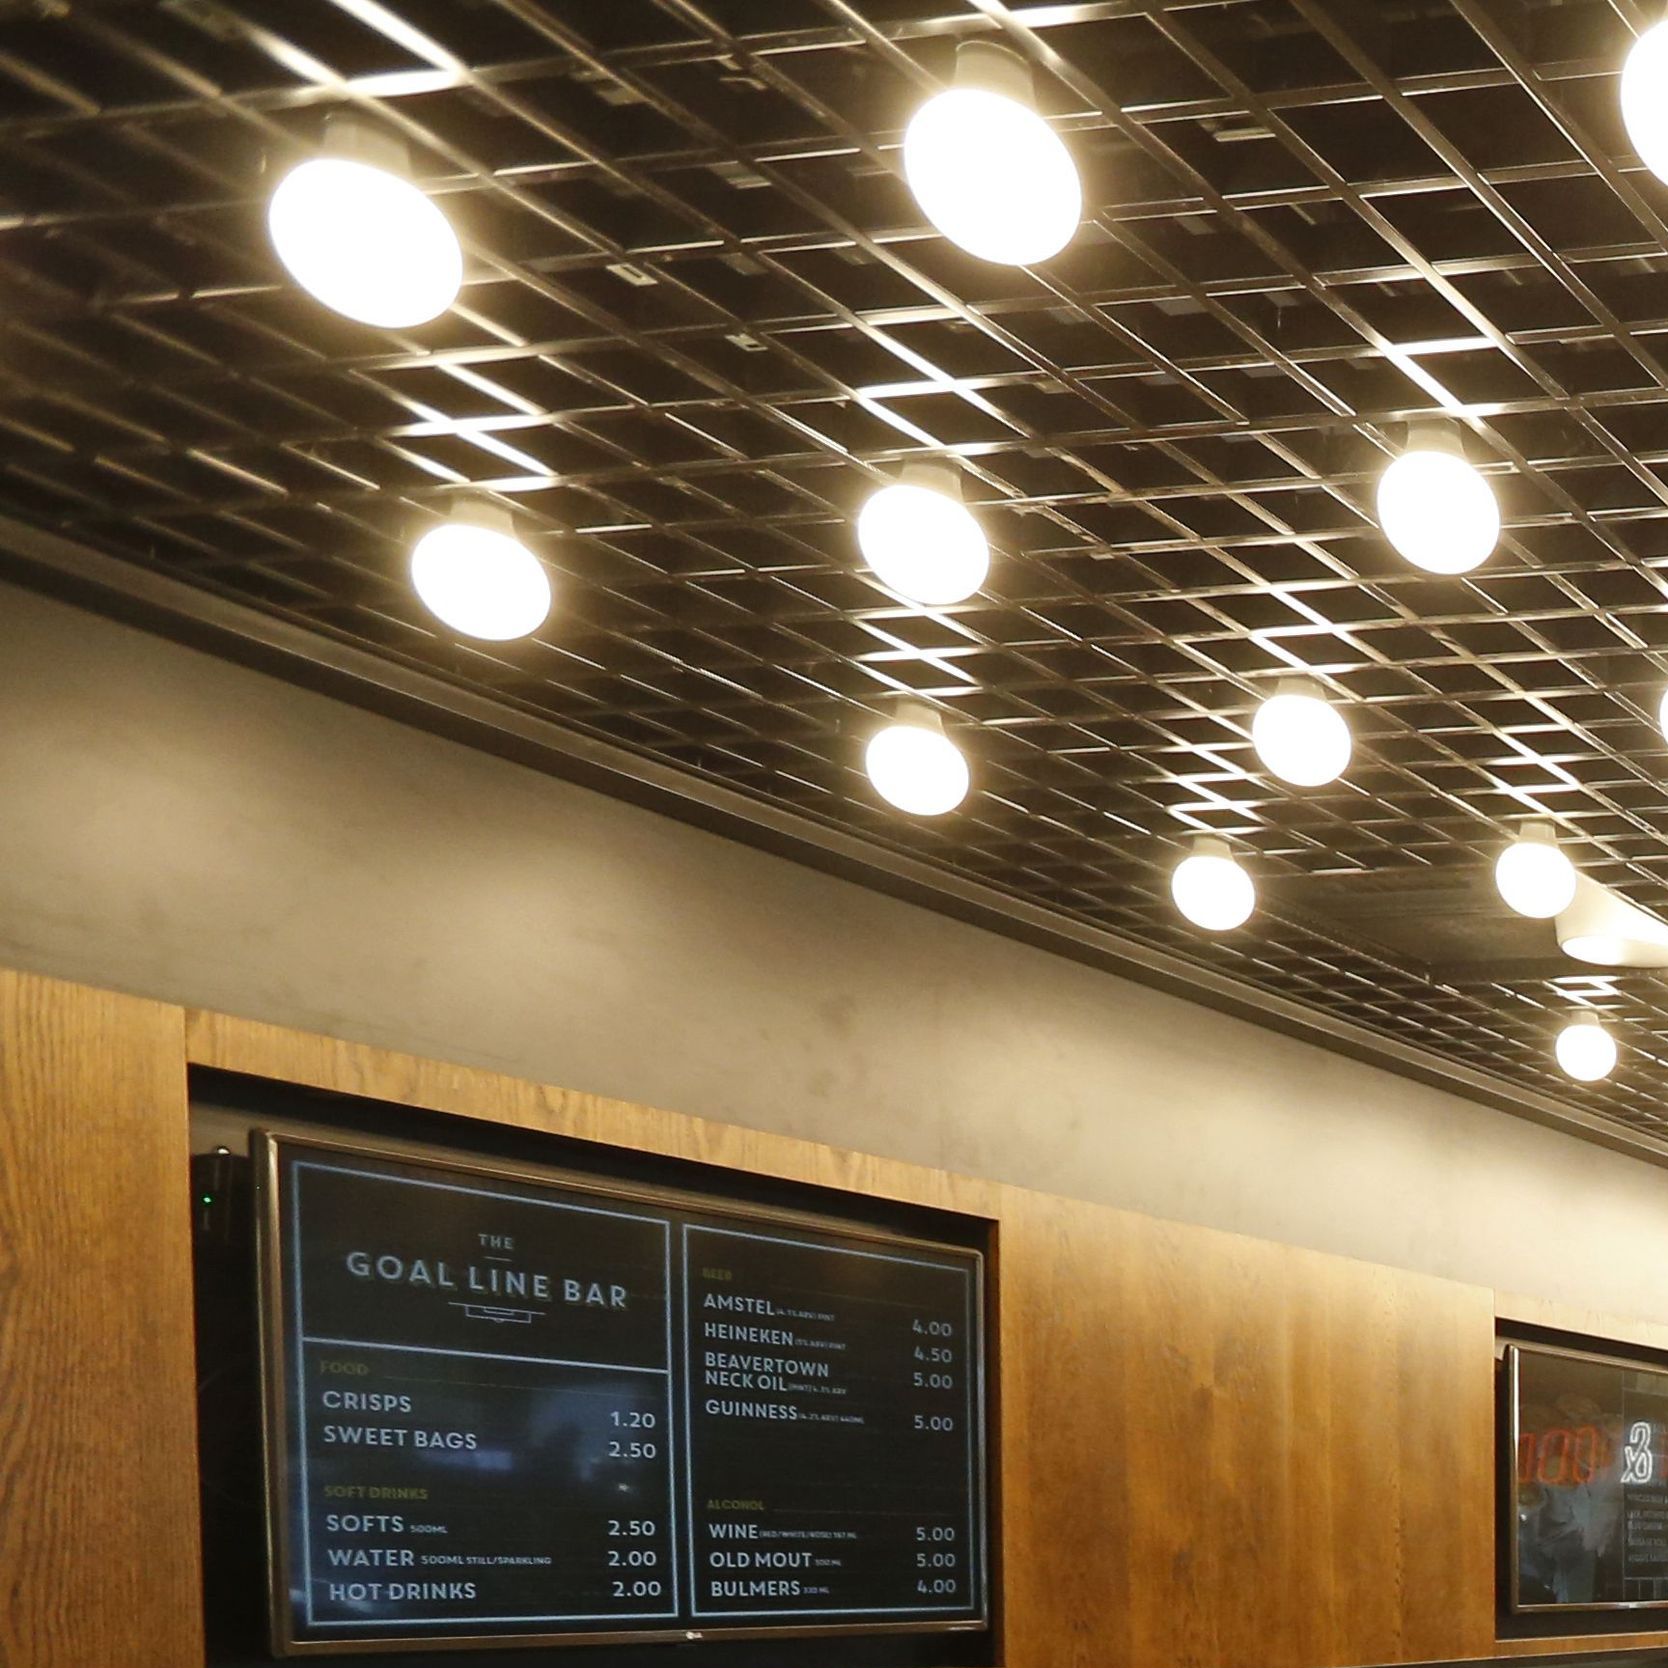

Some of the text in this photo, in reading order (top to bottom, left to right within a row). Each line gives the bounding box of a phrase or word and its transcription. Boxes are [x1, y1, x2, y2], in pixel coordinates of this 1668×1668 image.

[478, 1233, 514, 1250] THE
[346, 1252, 627, 1308] GOAL LINE BAR
[704, 1292, 775, 1316] AMSTEL
[912, 1318, 953, 1337] 4.00
[704, 1321, 794, 1346] HEINEKEN
[914, 1345, 953, 1363] 4.50
[319, 1358, 369, 1377] FOOD
[704, 1351, 953, 1389] BEAVERTOWN 5.00
[704, 1370, 755, 1389] NECK
[757, 1374, 788, 1392] OIL
[322, 1390, 656, 1429] CRISPS 1.20
[705, 1399, 798, 1420] GUINNESS
[914, 1414, 954, 1432] 5.00
[323, 1425, 656, 1459] SWEET BAGS 2.50
[323, 1484, 429, 1500] SOFT DRINKS
[707, 1498, 765, 1511] ALCOHOL
[326, 1514, 404, 1533] SOFTS
[607, 1520, 656, 1537] 2.50
[708, 1523, 759, 1539] WINE
[915, 1527, 955, 1542] 5.00
[327, 1549, 415, 1567] WATER
[421, 1555, 464, 1565] 500ML
[608, 1551, 657, 1567] 2.00
[709, 1552, 751, 1568] OLD
[755, 1552, 812, 1568] MOUT
[916, 1553, 956, 1568] 5.00
[329, 1580, 662, 1601] HOT DRINKS 2.00
[711, 1580, 801, 1597] BULMERS
[916, 1579, 956, 1594] 4.00
